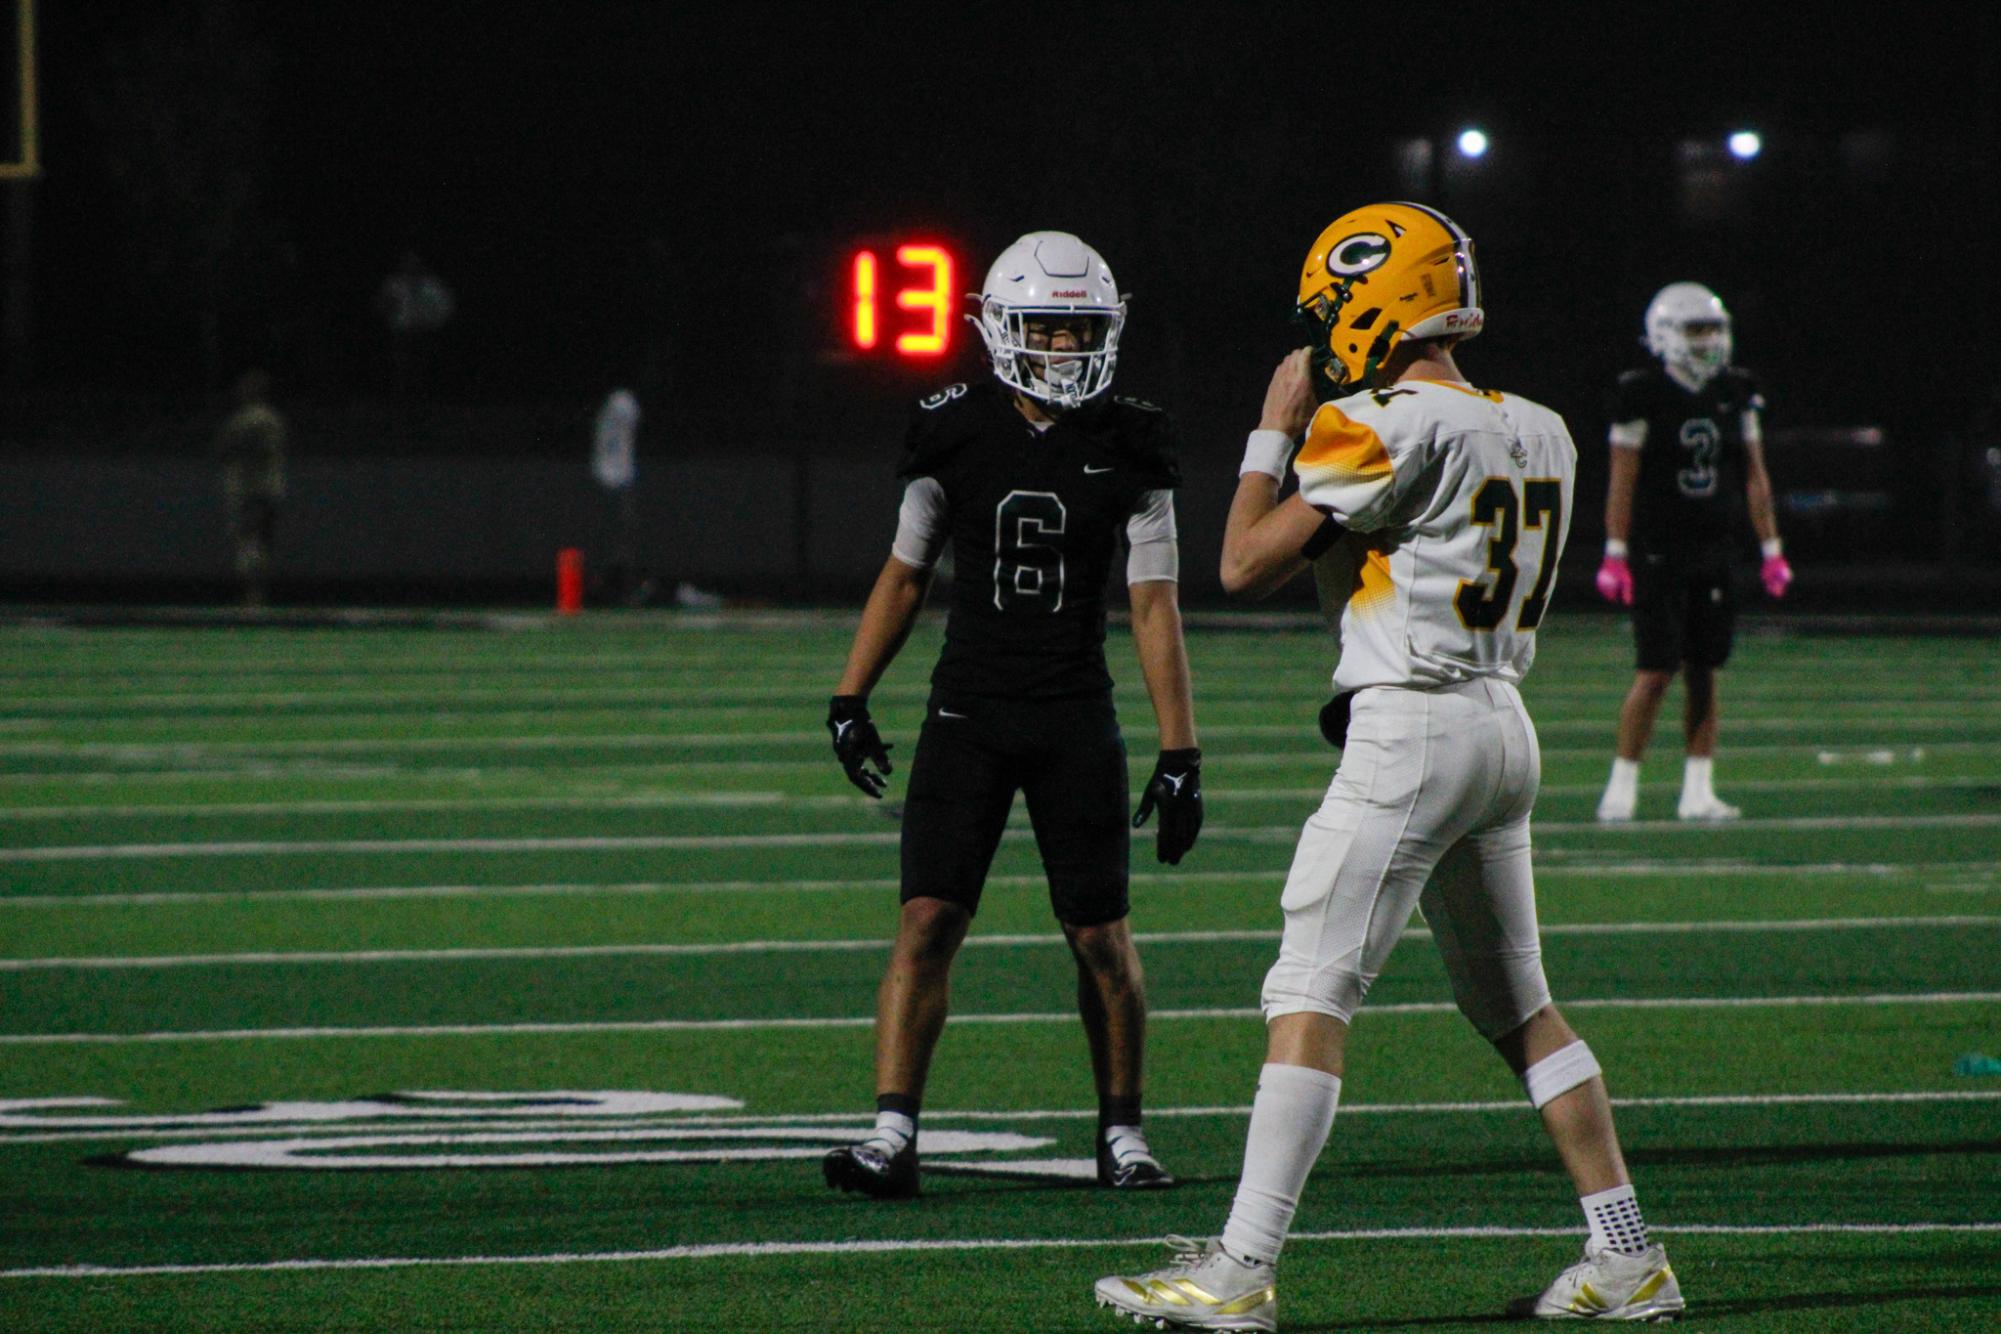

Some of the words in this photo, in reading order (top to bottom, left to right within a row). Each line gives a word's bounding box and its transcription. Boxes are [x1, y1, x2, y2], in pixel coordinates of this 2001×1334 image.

[852, 247, 951, 354] 13
[1052, 290, 1087, 298] Riddell
[1327, 233, 1390, 277] C
[1675, 416, 1721, 498] 3
[994, 489, 1067, 614] 6
[1453, 475, 1562, 632] 37
